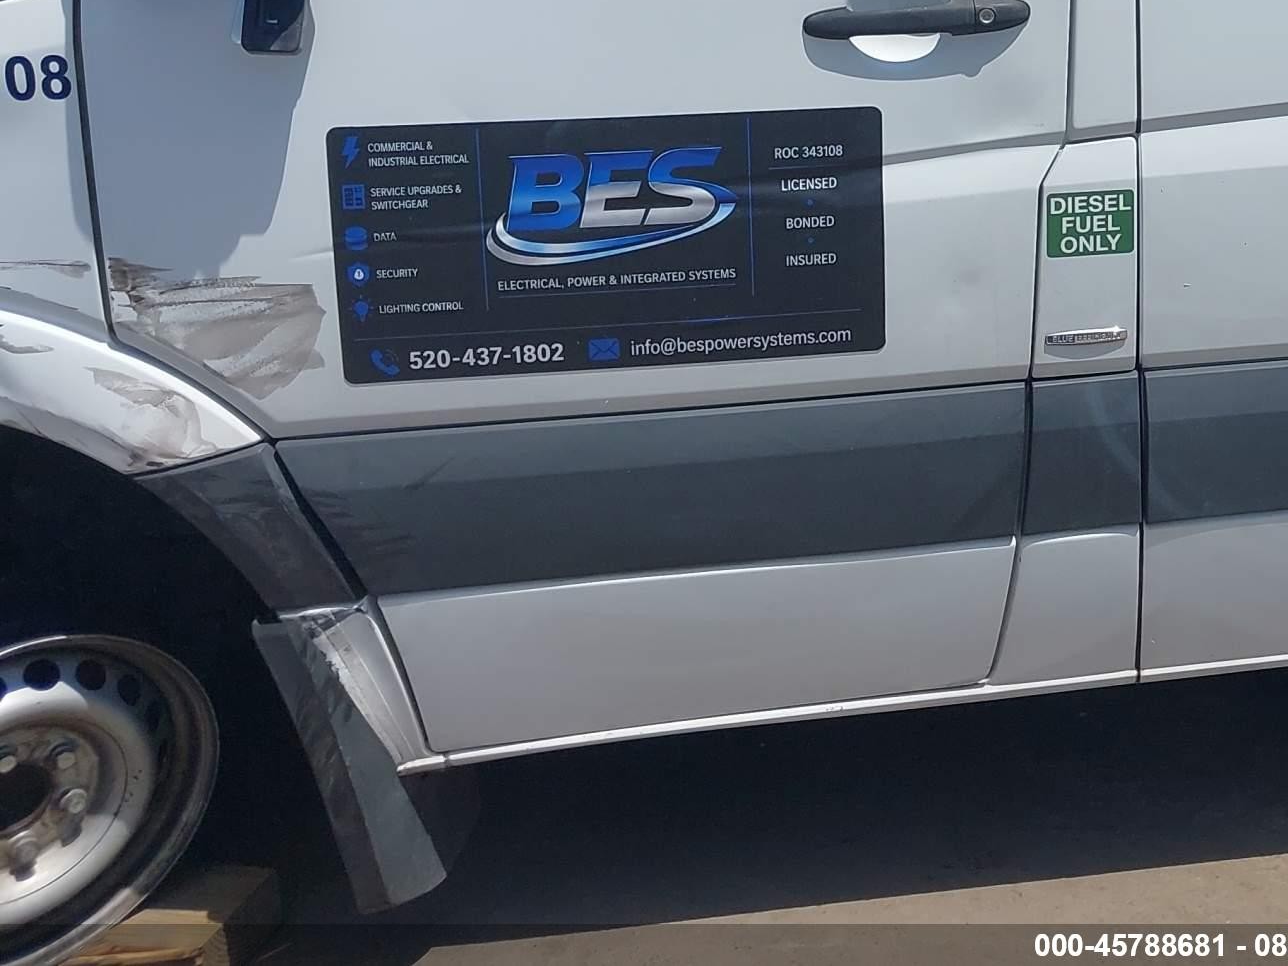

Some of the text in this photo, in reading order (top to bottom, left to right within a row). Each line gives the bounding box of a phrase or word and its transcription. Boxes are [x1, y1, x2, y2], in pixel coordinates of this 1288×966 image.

[5, 55, 72, 101] 08
[367, 141, 433, 153] COMMERCIAL &
[774, 144, 843, 160] ROC 343108
[368, 154, 469, 168] INDUSTRIAL ELECTRICAL
[370, 184, 462, 197] SERVICE UPGRADES &
[506, 146, 722, 232] BES
[781, 177, 837, 191] LICENSED
[371, 199, 428, 211] SWITCHGEAR
[1050, 194, 1131, 215] DIESEL
[785, 215, 835, 229] BONDED
[1061, 214, 1121, 234] FUEL
[373, 232, 397, 242] DATA
[1060, 233, 1122, 254] ONLY
[785, 253, 837, 267] INSURED
[376, 267, 418, 279] SECURITY
[497, 268, 736, 291] ELECTRICAL, POWER & INTEGRATED SYSTEMS
[378, 301, 464, 314] LIGHTING CONTROL
[630, 328, 852, 356] info@bespowersystems.com
[408, 342, 565, 370] 520-437-1802
